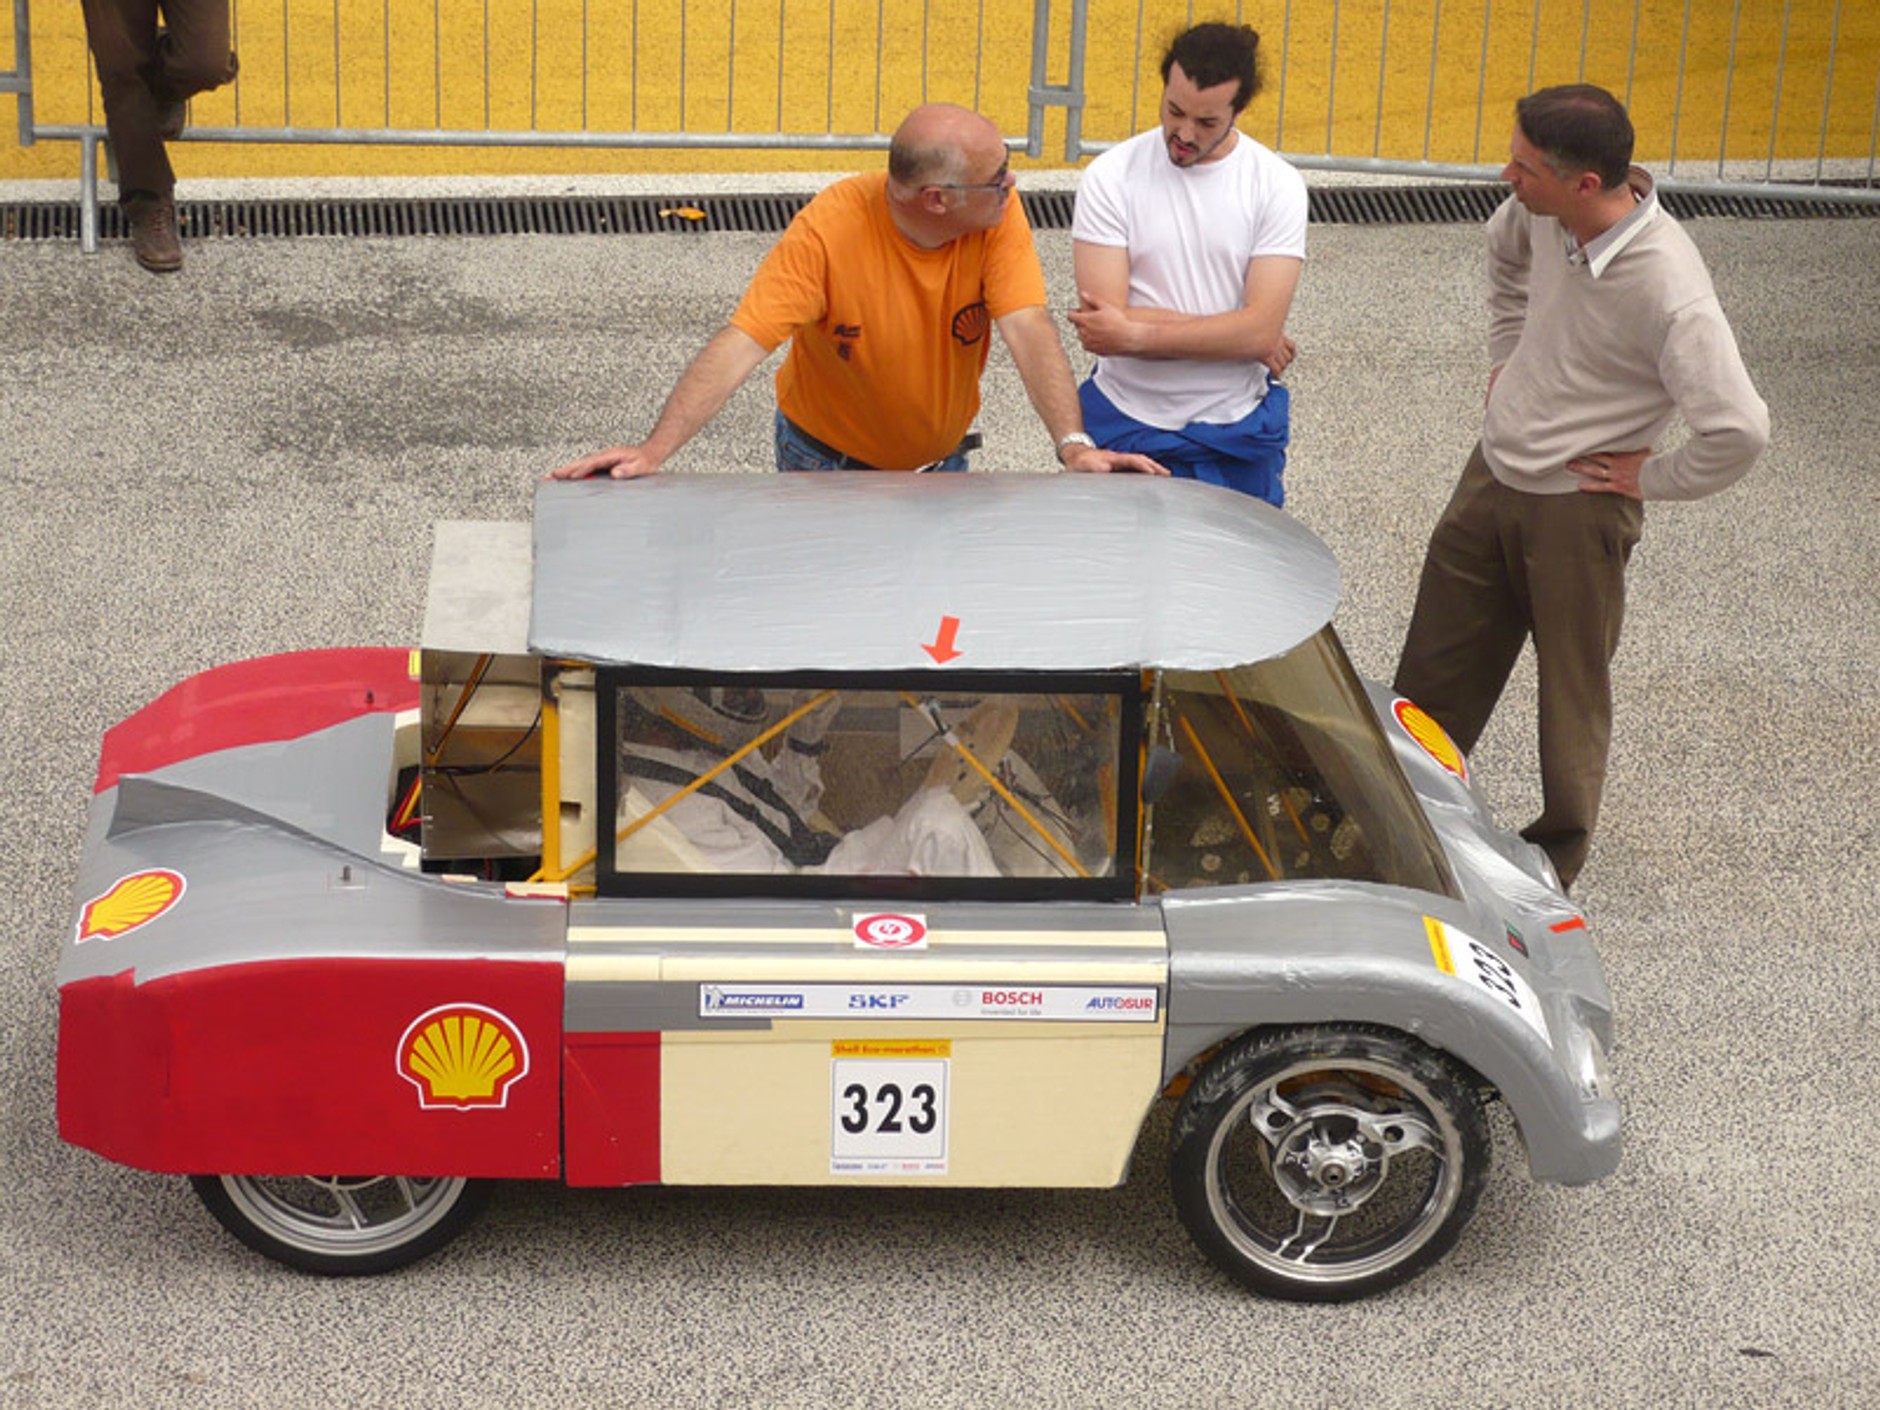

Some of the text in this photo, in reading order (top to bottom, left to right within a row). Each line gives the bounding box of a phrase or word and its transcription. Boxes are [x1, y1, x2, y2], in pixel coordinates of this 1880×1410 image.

[1469, 942, 1521, 1009] 323
[723, 995, 801, 1007] MICHELIN
[849, 994, 909, 1008] SKF
[982, 991, 1042, 1004] BOSCH
[1086, 997, 1153, 1009] AUTOSUR
[841, 1083, 936, 1134] 323
